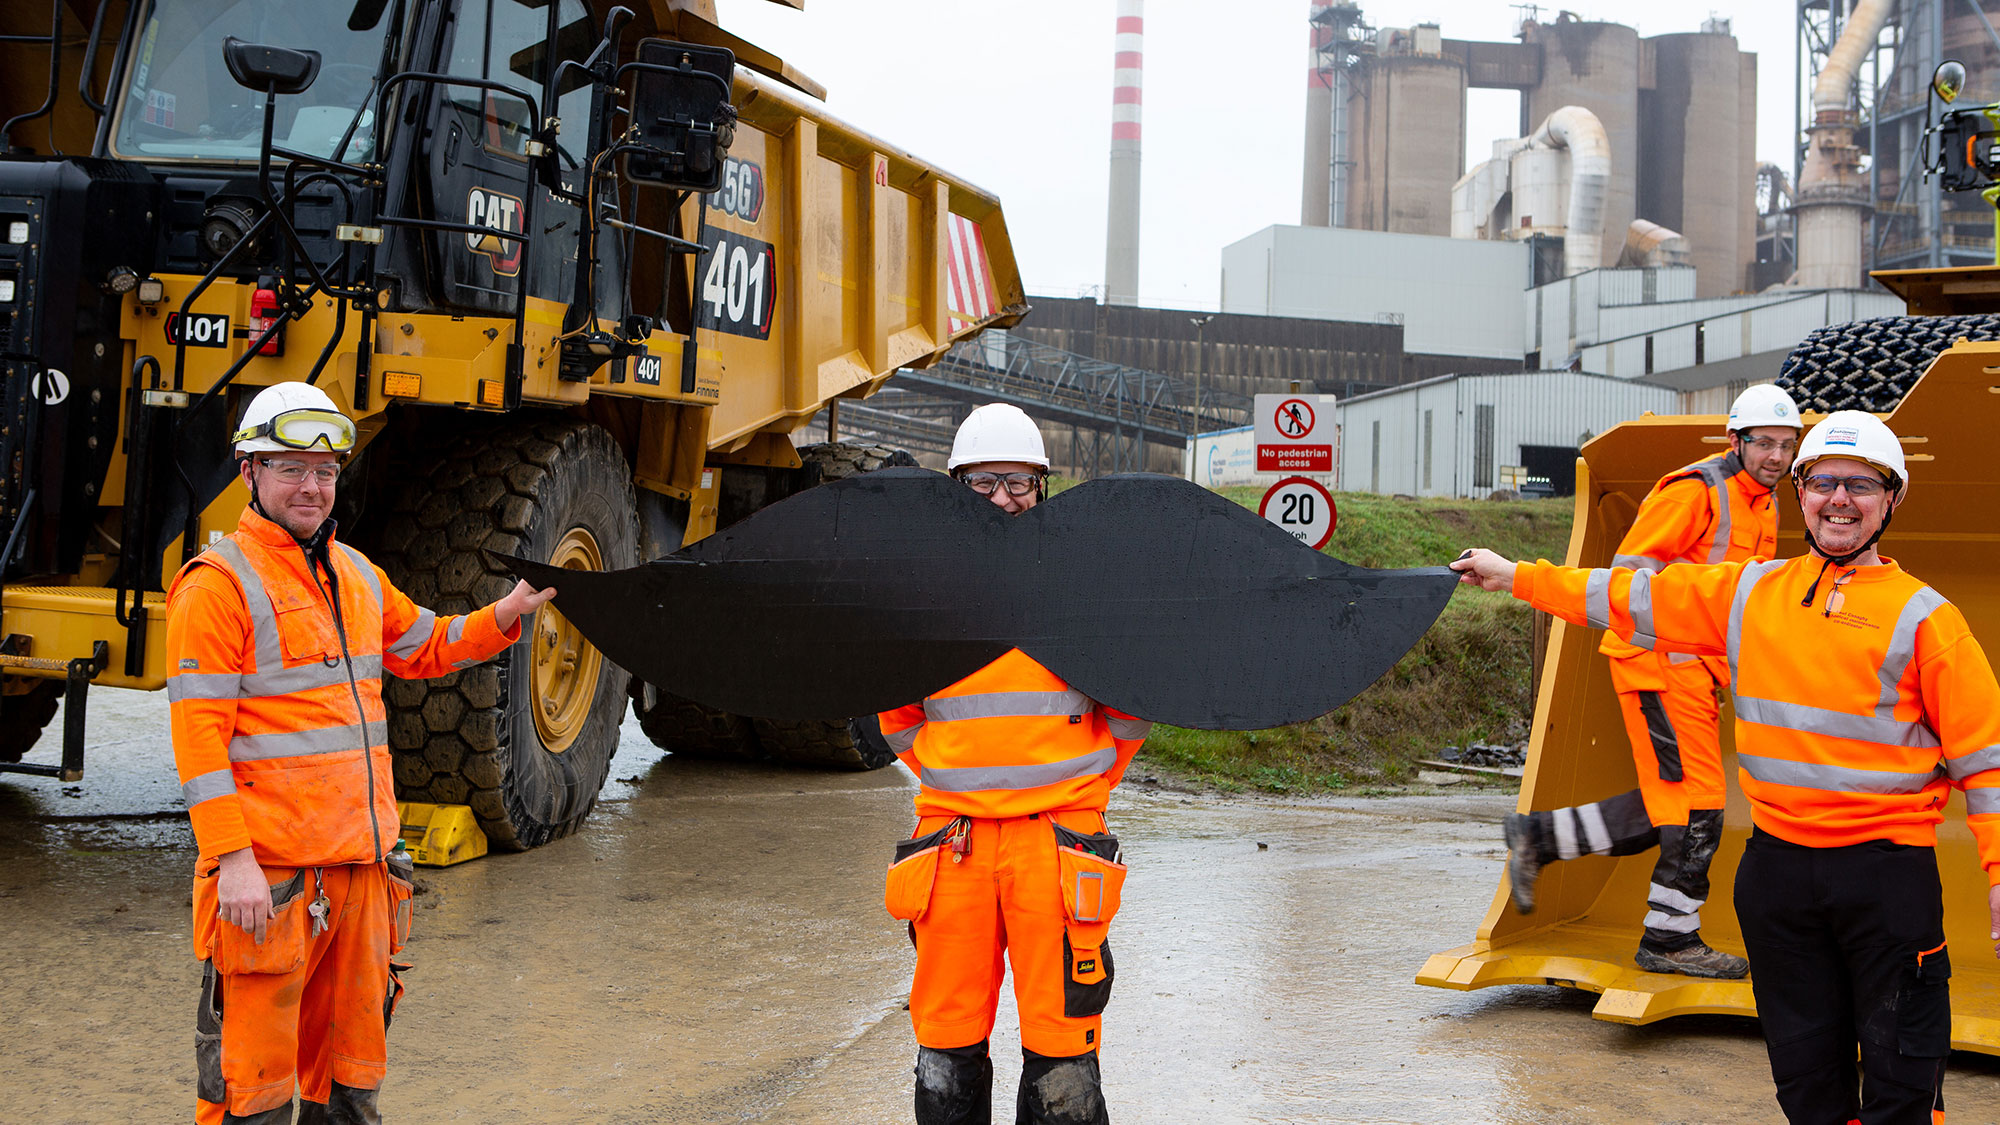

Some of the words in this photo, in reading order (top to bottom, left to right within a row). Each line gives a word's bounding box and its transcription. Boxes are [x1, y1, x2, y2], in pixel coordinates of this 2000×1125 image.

[467, 189, 516, 255] CAT
[703, 240, 766, 327] 401
[638, 357, 660, 381] 401
[1261, 448, 1275, 458] No
[1278, 448, 1328, 459] pedestrian
[1278, 459, 1311, 468] access
[1281, 493, 1315, 525] 20
